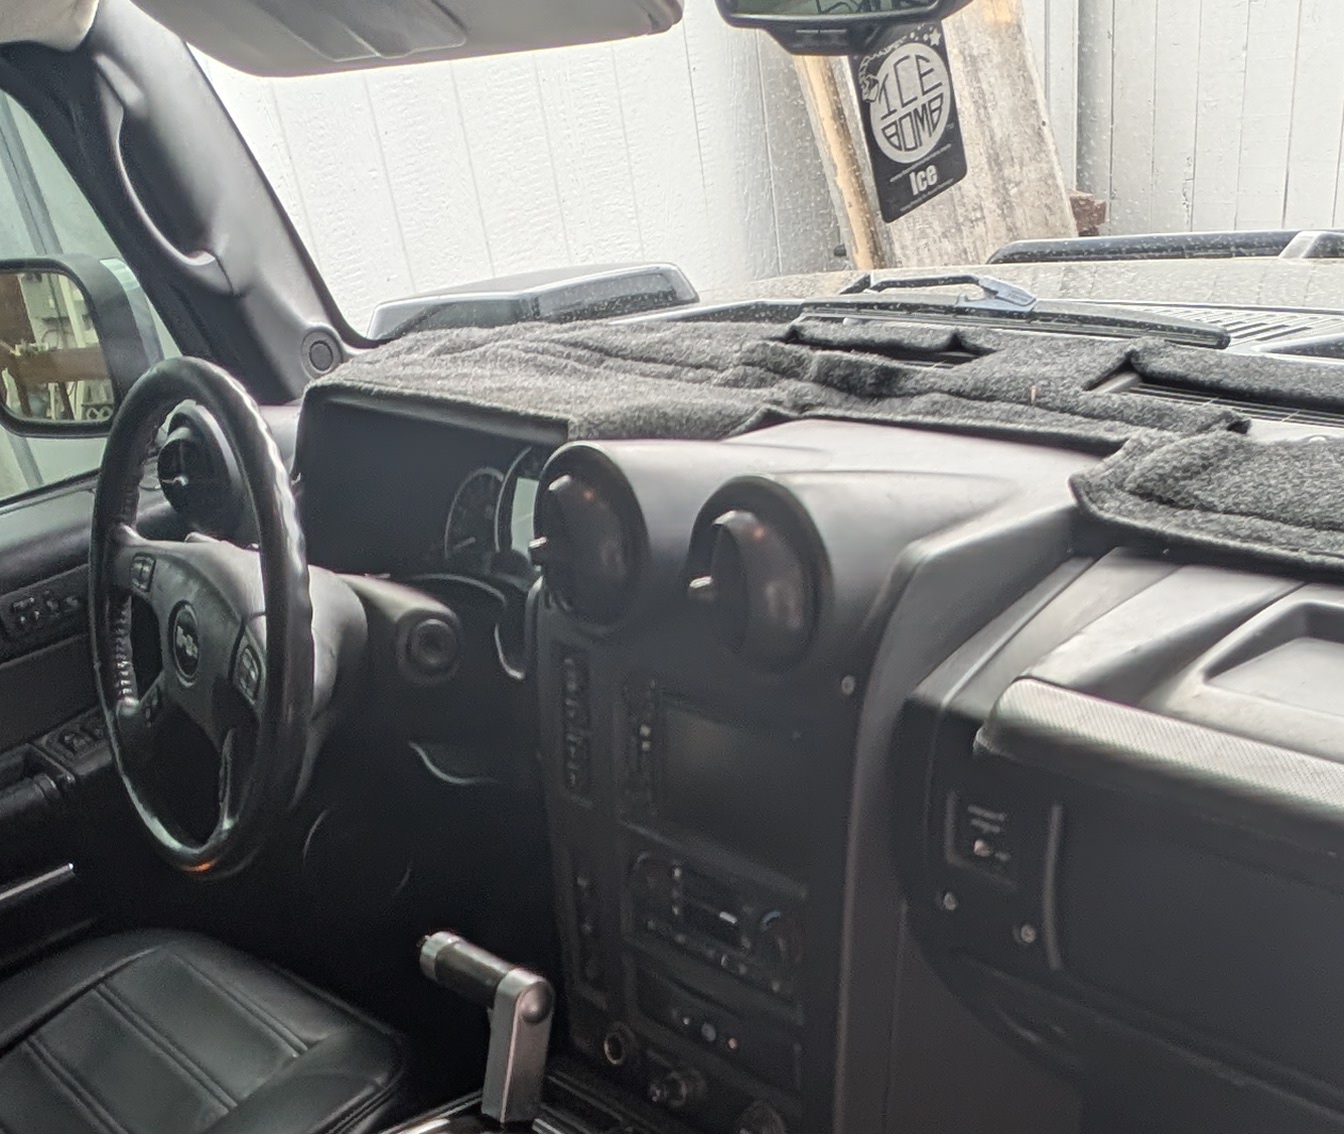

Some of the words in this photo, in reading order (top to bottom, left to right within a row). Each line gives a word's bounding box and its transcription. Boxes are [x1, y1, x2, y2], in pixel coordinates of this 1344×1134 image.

[878, 54, 943, 120] ICE
[880, 93, 944, 151] BOMB
[909, 164, 938, 196] Ice
